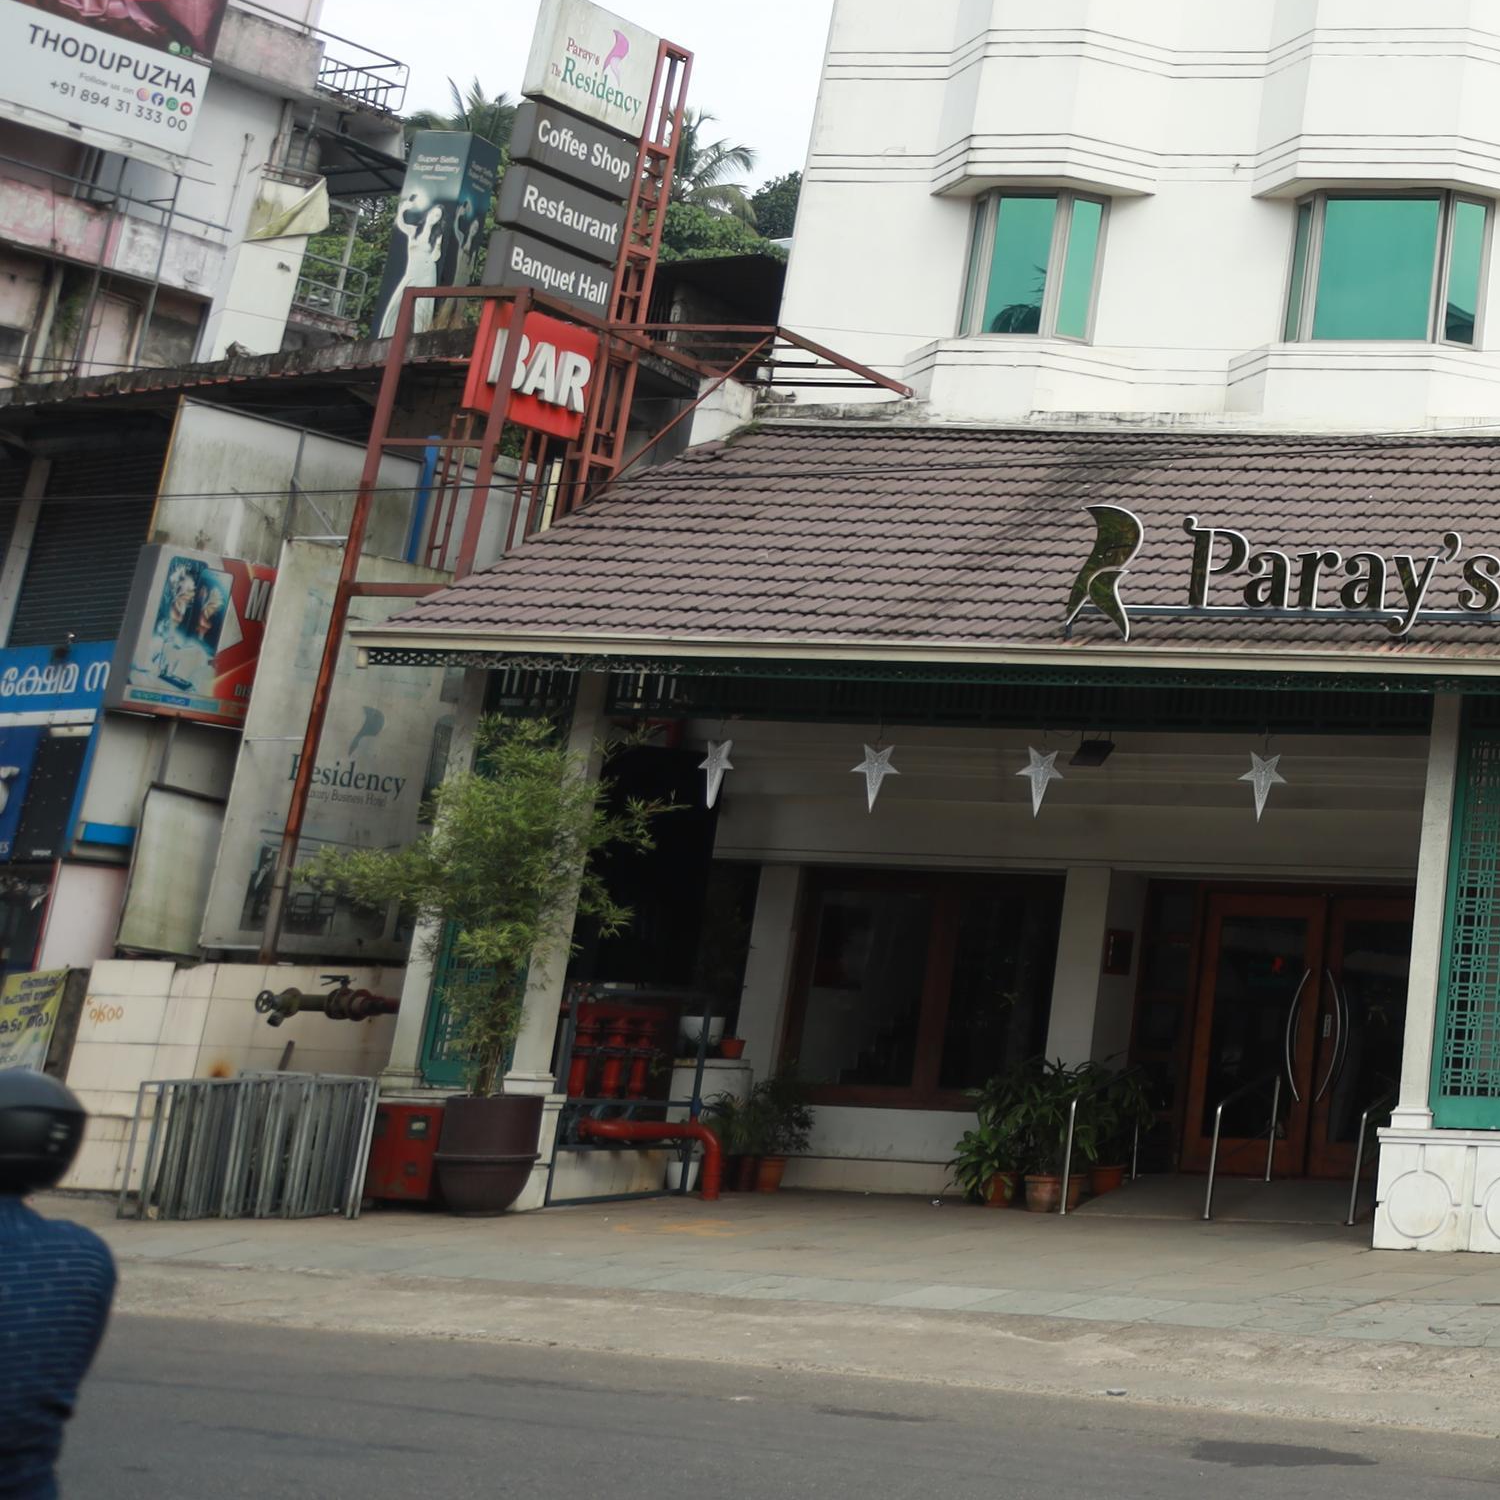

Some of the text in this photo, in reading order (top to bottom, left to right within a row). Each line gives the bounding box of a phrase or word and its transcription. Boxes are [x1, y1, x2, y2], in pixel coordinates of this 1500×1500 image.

[28, 23, 197, 98] THODUPUZHA
[561, 56, 642, 121] Residency
[50, 78, 188, 132] +91 894 31 333 00
[538, 119, 631, 182] Coffee Shop
[523, 185, 618, 245] Restaurant
[511, 246, 608, 305] Banquet Hall
[487, 328, 591, 414] BAR
